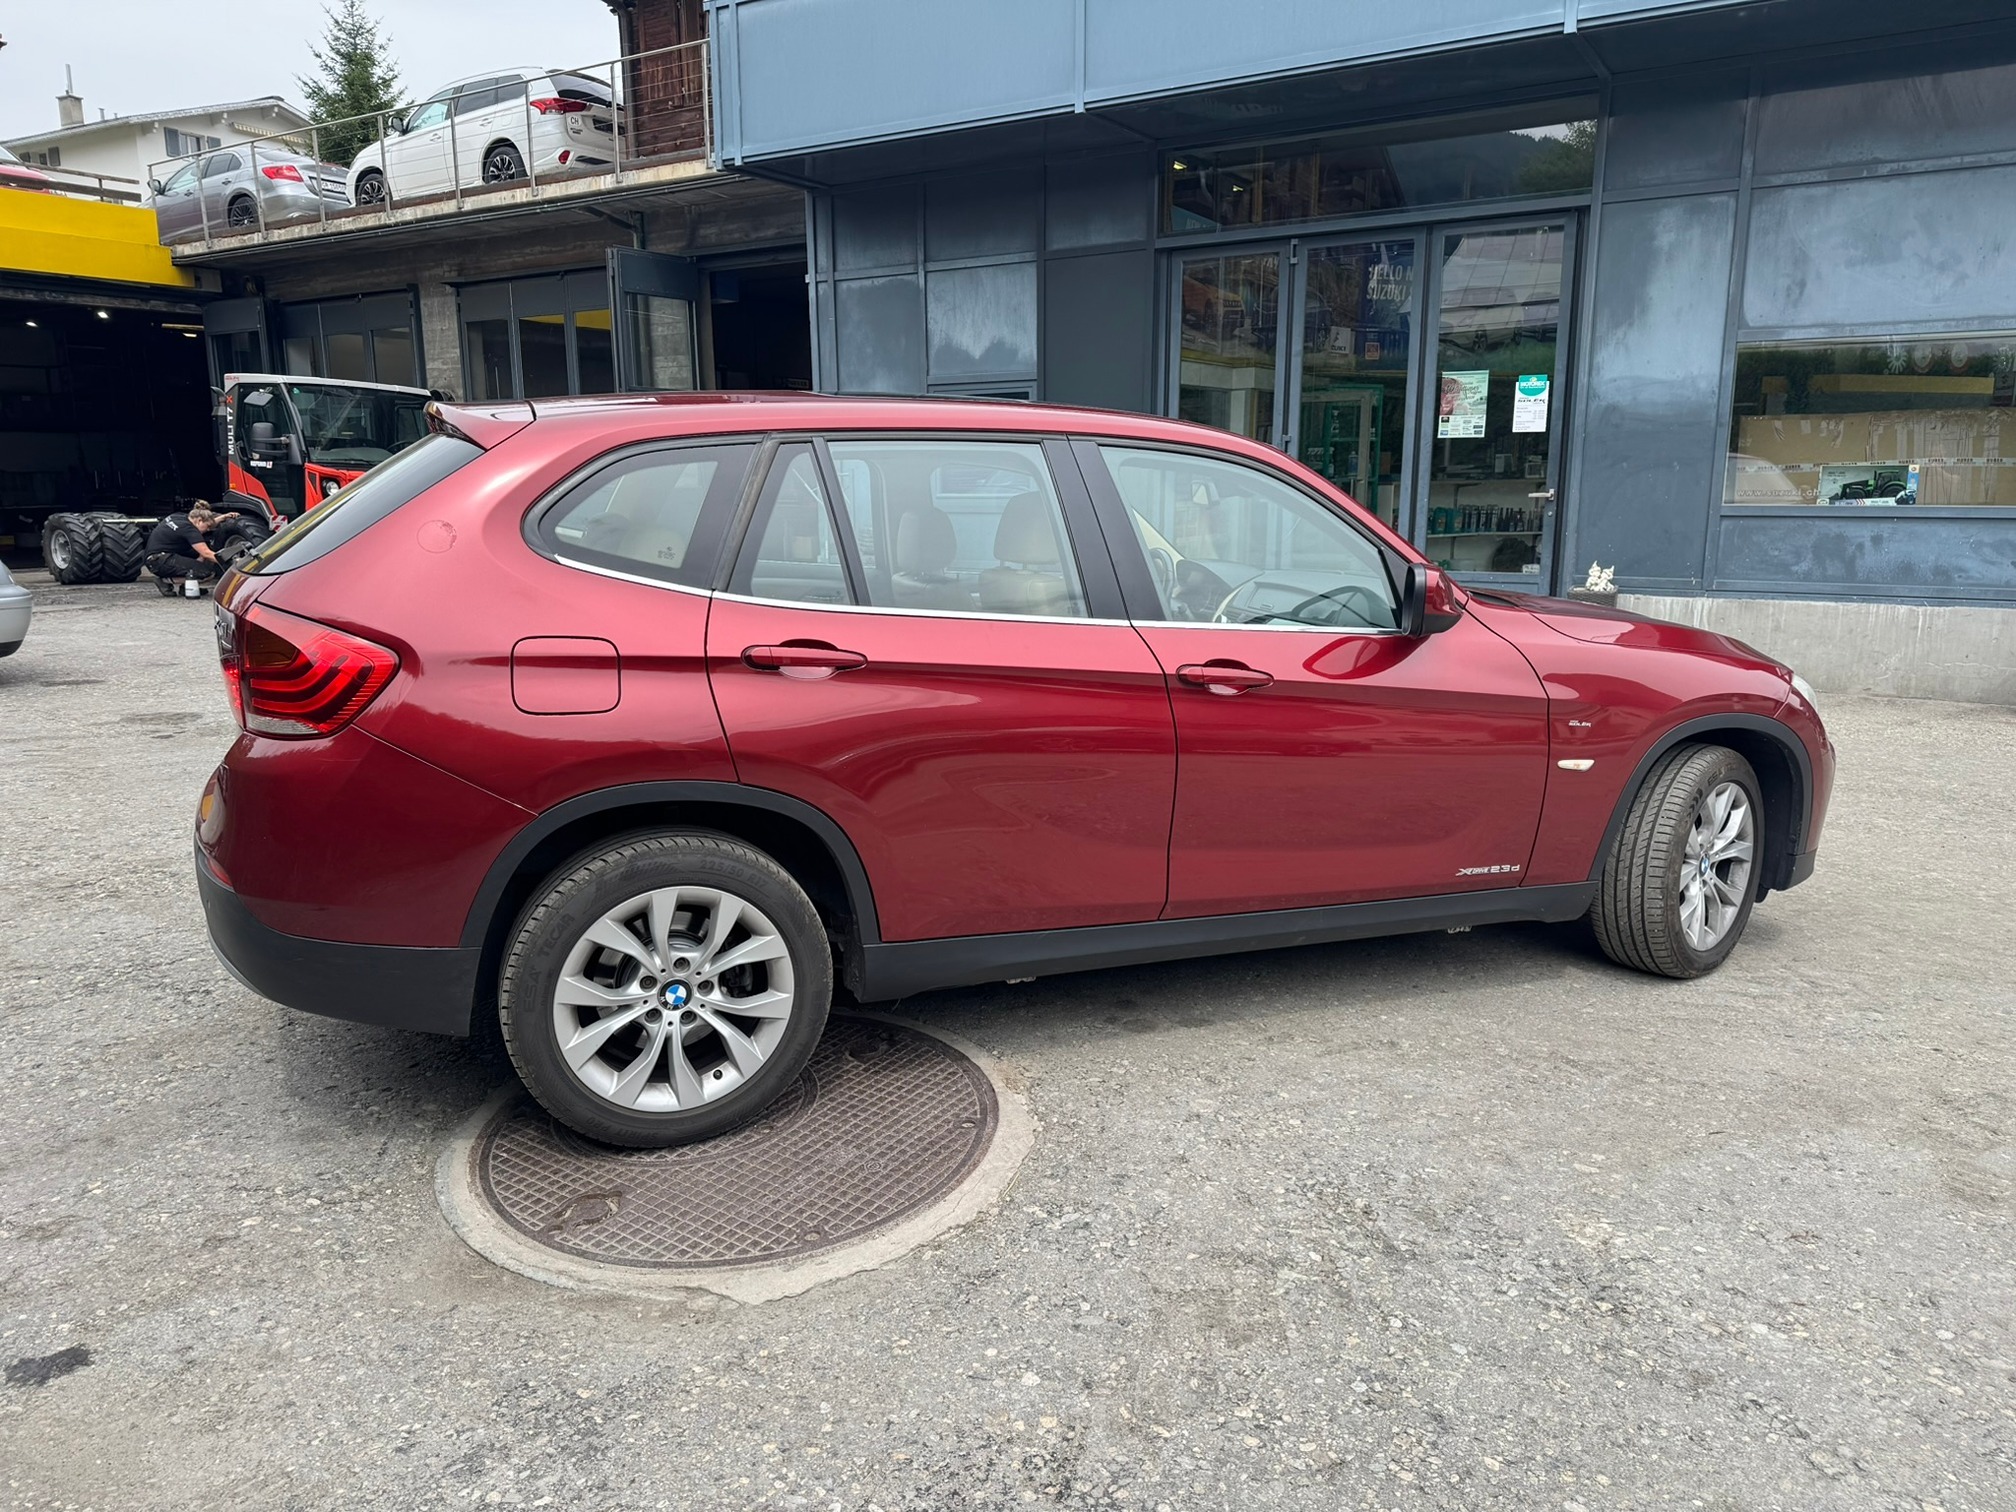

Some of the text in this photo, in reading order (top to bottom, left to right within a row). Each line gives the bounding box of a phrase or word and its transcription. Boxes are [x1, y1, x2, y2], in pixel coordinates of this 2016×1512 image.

[571, 117, 579, 125] CH
[1369, 264, 1403, 280] HELLO
[1366, 284, 1406, 300] SUZUKI
[226, 406, 233, 422] T7
[227, 425, 235, 455] MULI
[1737, 488, 1819, 497] www.suzuki.ch
[699, 859, 769, 888] 225/50 R17
[537, 913, 575, 957] TECAR
